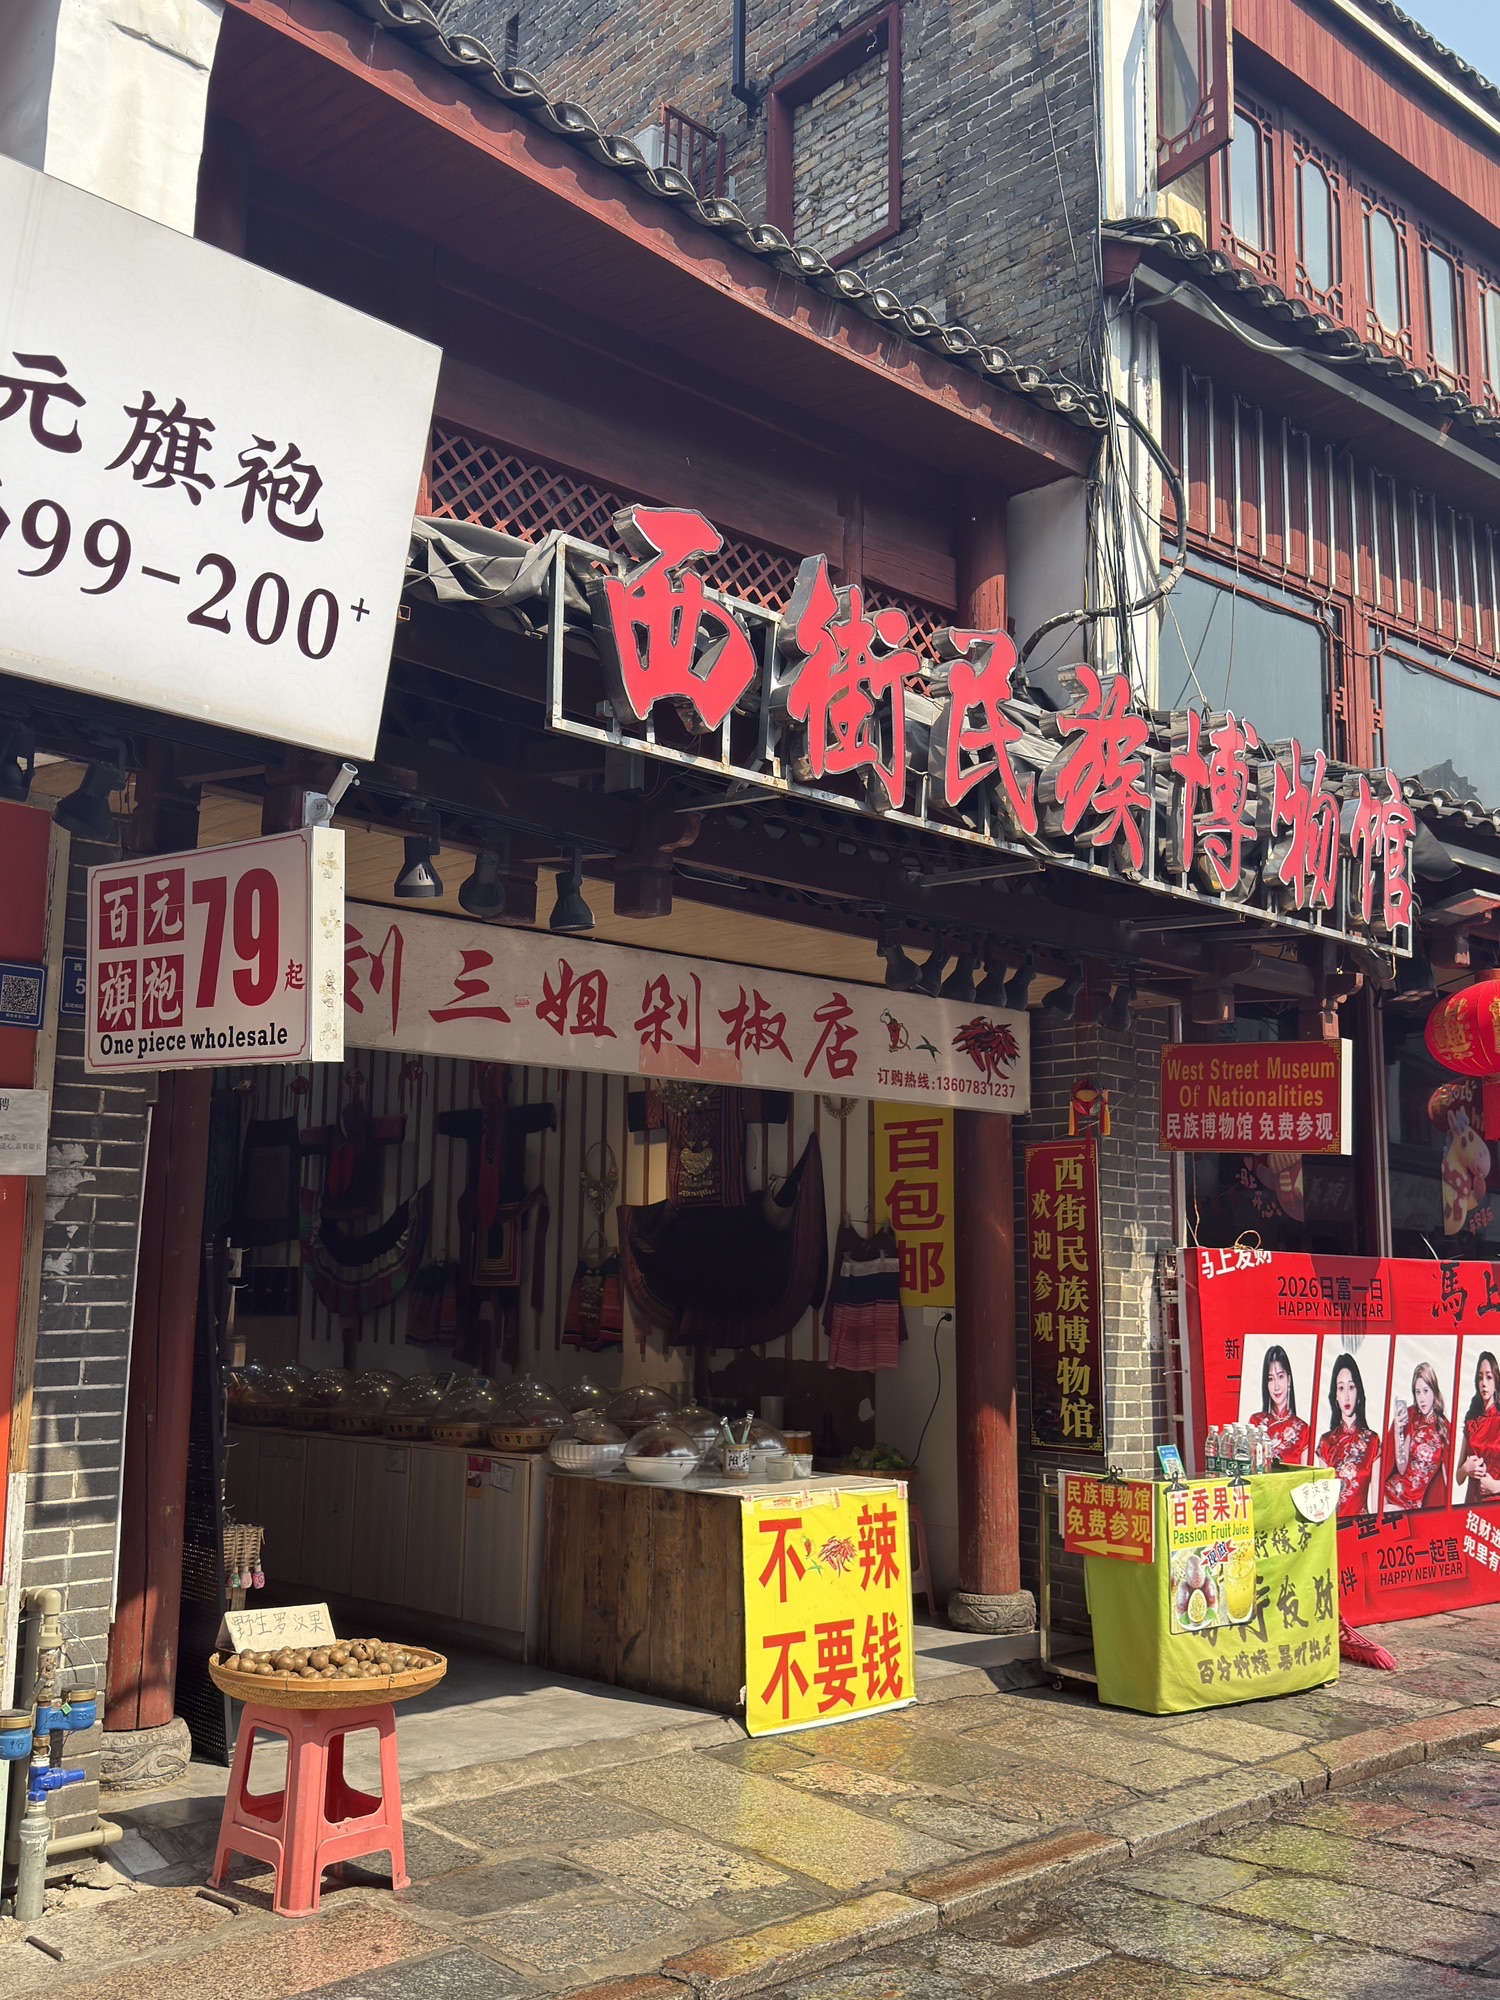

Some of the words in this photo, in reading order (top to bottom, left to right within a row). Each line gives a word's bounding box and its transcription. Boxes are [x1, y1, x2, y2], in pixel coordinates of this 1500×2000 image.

[0, 351, 324, 542] 元旗袍
[0, 478, 370, 660] 99-200+
[604, 505, 1416, 931] 西街民族博物馆
[104, 878, 183, 943] 百元
[192, 867, 279, 1009] 79
[100, 957, 182, 1027] 旗袍
[284, 958, 306, 992] 起
[100, 1032, 134, 1056] One
[138, 1028, 186, 1059] piece
[190, 1022, 288, 1050] wholesale
[1167, 1058, 1204, 1081] West
[1210, 1058, 1259, 1081] Street
[1267, 1056, 1336, 1080] Museum
[1179, 1085, 1200, 1107] Of
[1208, 1084, 1324, 1107] Nationalities
[1166, 1111, 1253, 1141] 民族博物馆
[1259, 1112, 1334, 1142] 免费参观
[884, 1117, 946, 1294] 百包邮
[1031, 1188, 1053, 1344] 欢迎参观
[1201, 1248, 1273, 1280] 马上发财
[1053, 1153, 1095, 1439] 西街民族博物馆
[1277, 1276, 1384, 1301] 2026日富一日
[1278, 1301, 1320, 1317] HAPPY
[1323, 1302, 1351, 1317] NEW
[1353, 1302, 1384, 1318] YEAR
[1067, 1480, 1150, 1512] 民族博物馆
[1170, 1486, 1250, 1527] 百香果汁
[1066, 1505, 1151, 1544] 免费参观
[1173, 1526, 1208, 1545] Passion
[1210, 1524, 1232, 1540] Fruit
[1232, 1524, 1250, 1537] Juice
[1376, 1537, 1460, 1570] 2026一起富
[1380, 1569, 1413, 1587] HAPPY
[1415, 1565, 1437, 1581] NEW
[1439, 1562, 1463, 1576] YEAR
[231, 1610, 327, 1640] 野生罗汉果
[760, 1612, 904, 1720] 不要钱
